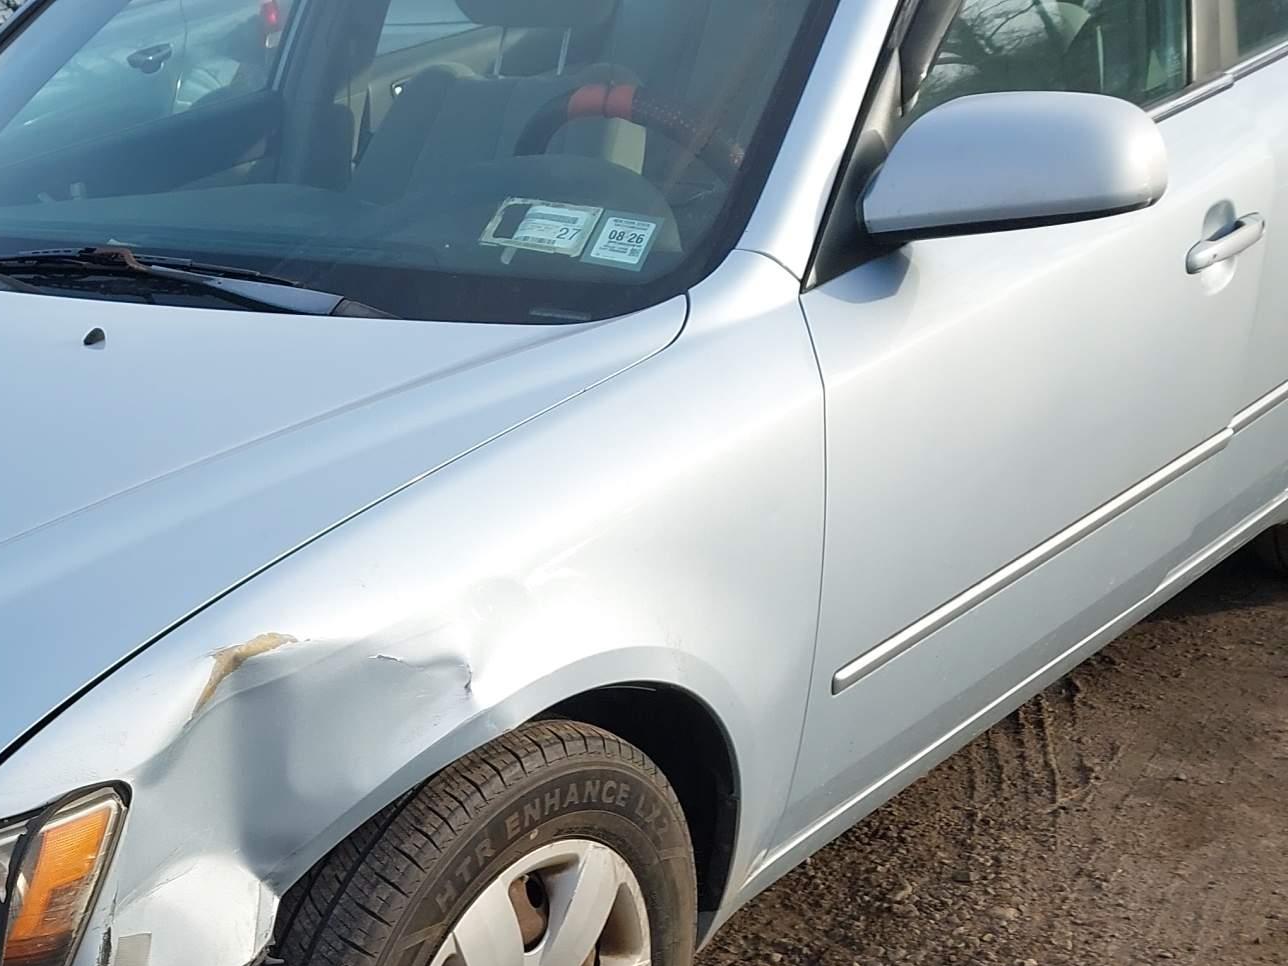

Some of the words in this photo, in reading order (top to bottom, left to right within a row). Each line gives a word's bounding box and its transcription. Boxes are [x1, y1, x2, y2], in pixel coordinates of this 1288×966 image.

[557, 227, 581, 241] 27
[608, 229, 626, 241] 08
[627, 232, 646, 245] 26
[435, 837, 497, 912] HTR
[503, 779, 632, 841] ENHANCE
